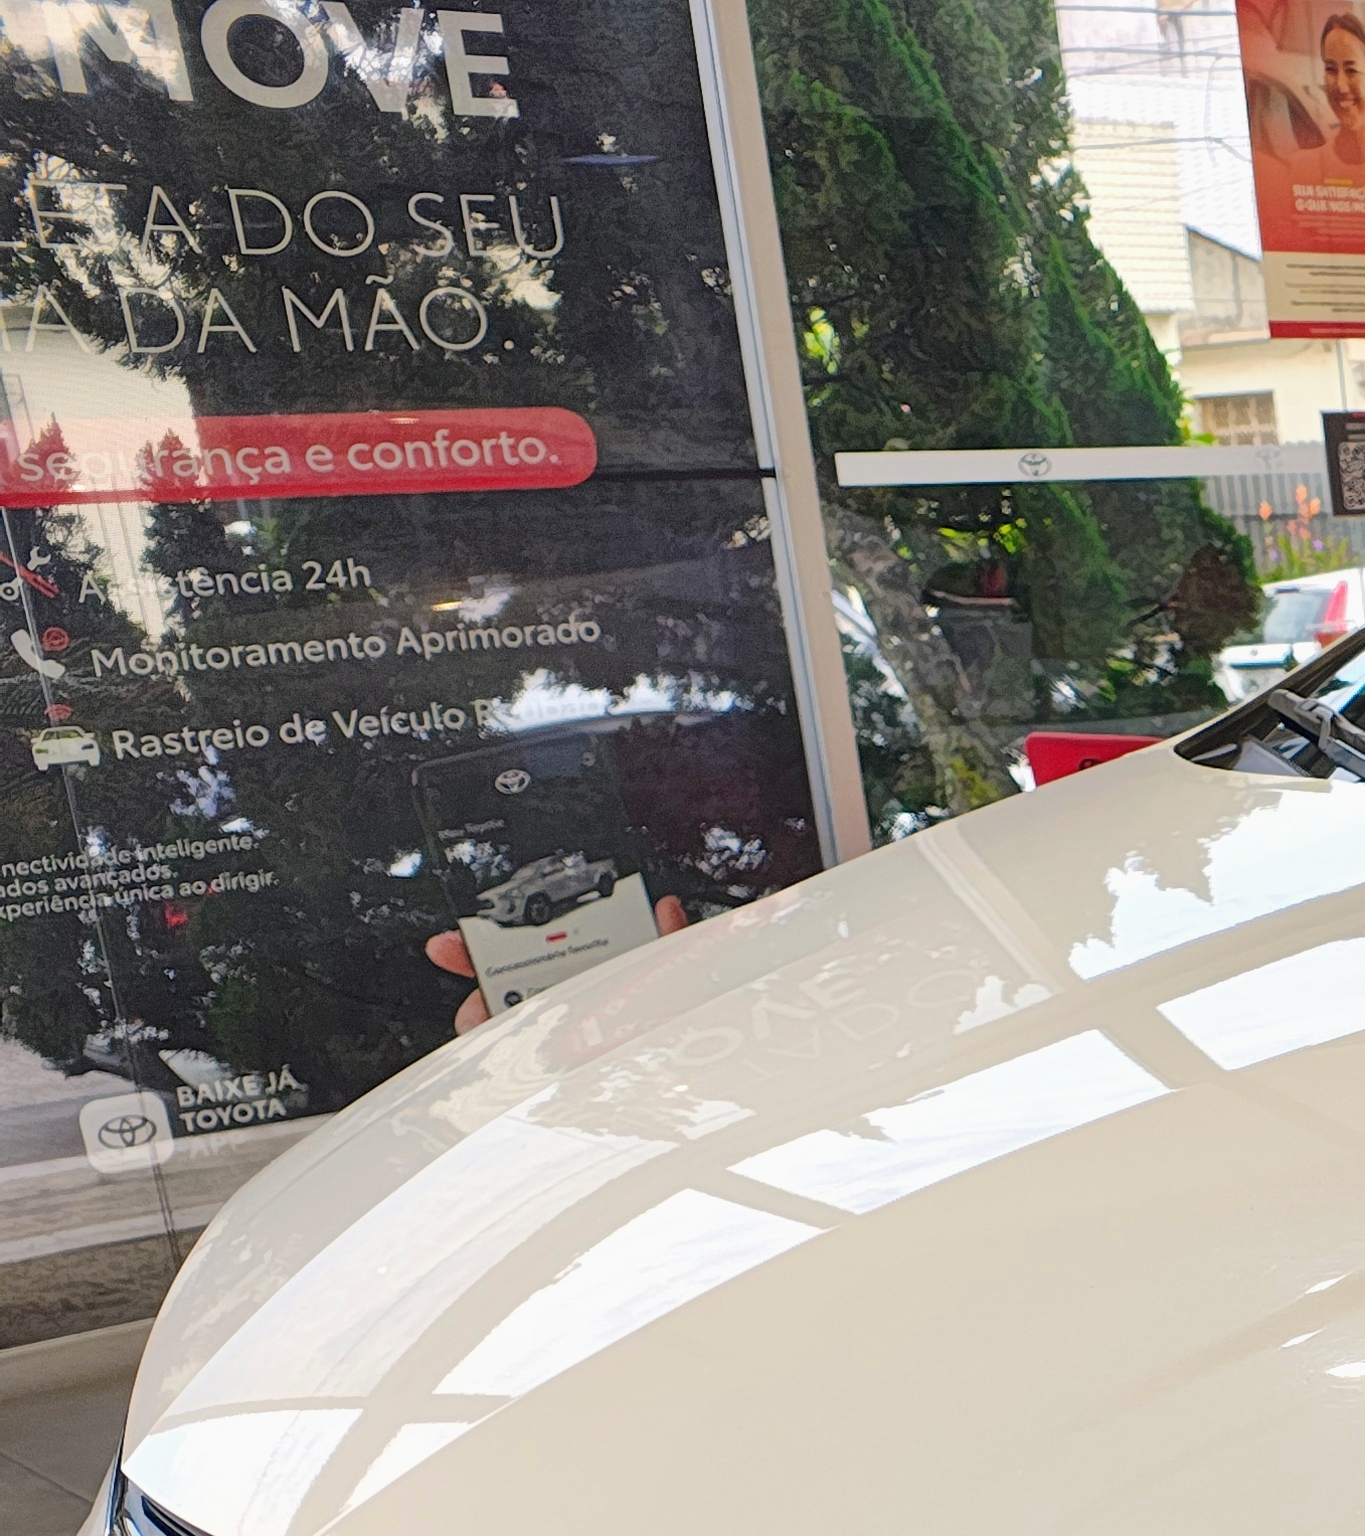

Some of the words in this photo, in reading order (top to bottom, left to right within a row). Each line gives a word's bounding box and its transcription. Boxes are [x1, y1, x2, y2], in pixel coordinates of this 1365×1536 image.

[40, 0, 520, 119] MOVE
[227, 186, 376, 258] DO
[406, 192, 566, 259] SEU
[118, 285, 258, 355] DA
[281, 274, 516, 355] MÃO.
[305, 443, 335, 473] e
[347, 430, 559, 474] conforto.
[302, 557, 372, 590] 24h
[90, 632, 386, 678] Monitoramento
[396, 609, 601, 661] Aprimorado
[112, 718, 270, 760] Rastreio
[279, 713, 327, 746] de
[331, 701, 467, 739] Veículo
[136, 833, 260, 861] inteligente.
[54, 863, 180, 892] avançados.
[114, 884, 175, 906] única
[179, 880, 207, 896] ao
[176, 1073, 261, 1108] BAIXE
[265, 1063, 302, 1095] JÁ
[178, 1097, 288, 1133] TOYOTA
